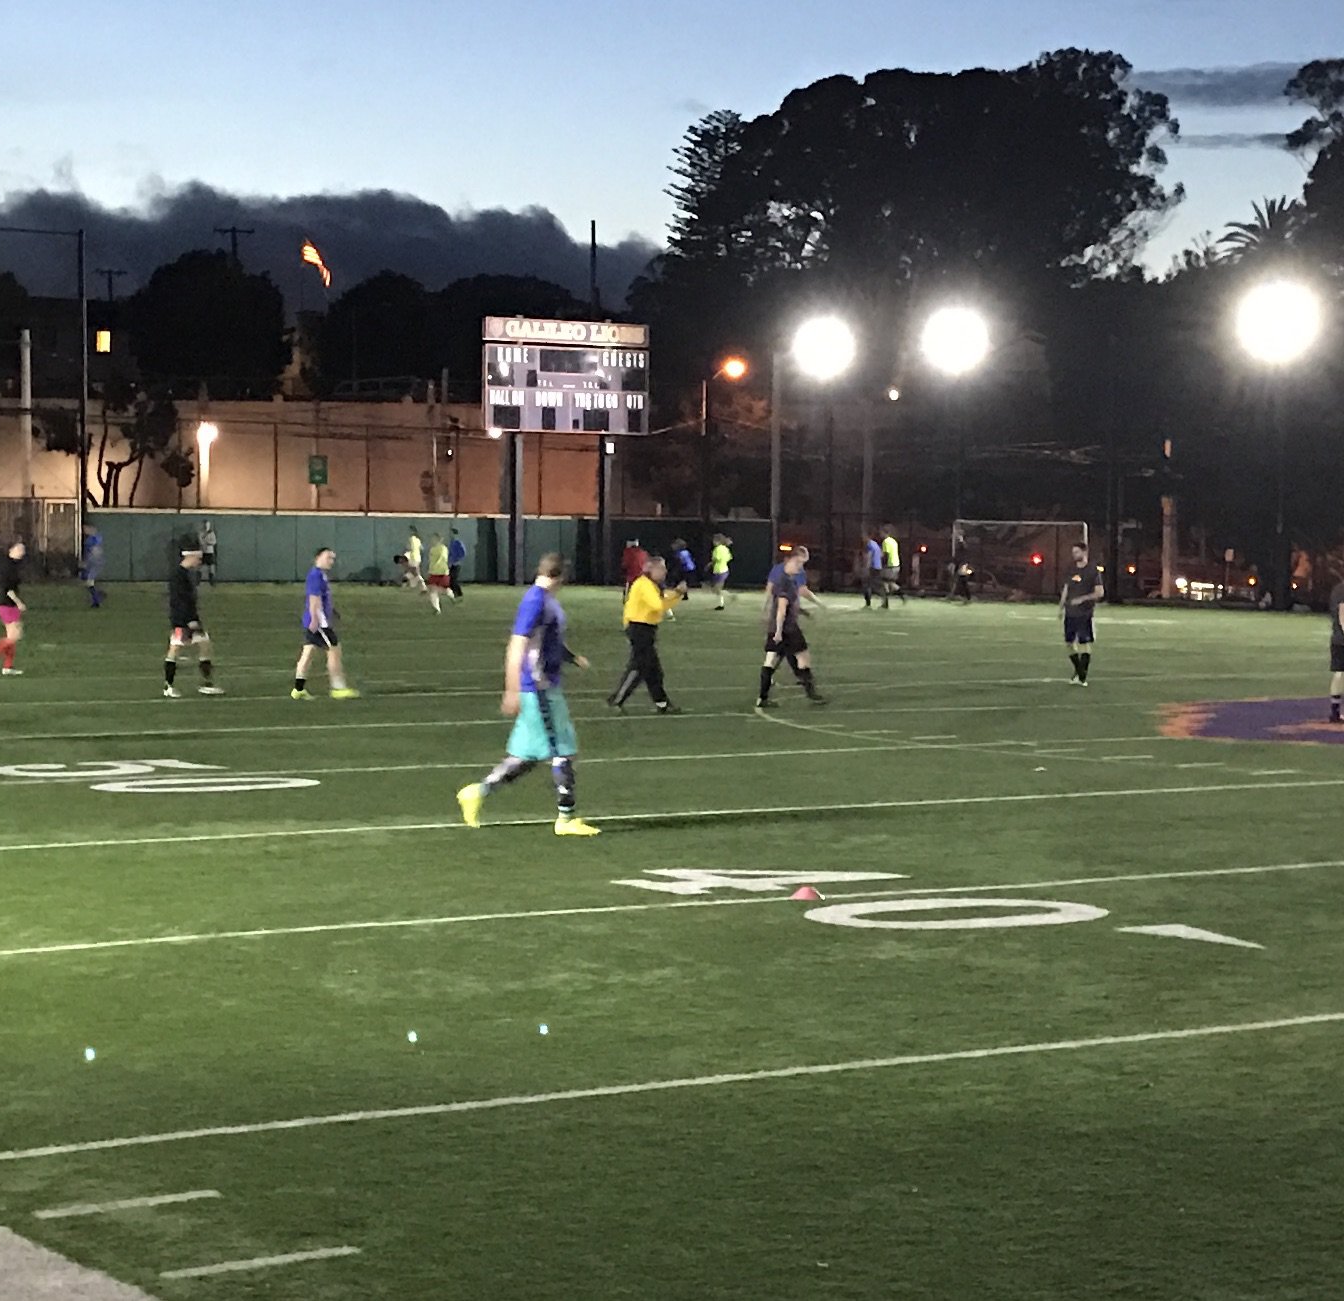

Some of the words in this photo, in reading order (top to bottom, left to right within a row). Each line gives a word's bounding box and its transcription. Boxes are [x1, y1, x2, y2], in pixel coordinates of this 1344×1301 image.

[505, 320, 587, 341] GALILEO
[497, 347, 528, 363] HOME
[602, 350, 644, 368] GUESTS
[535, 391, 564, 407] DOWN
[609, 867, 1112, 930] 40
